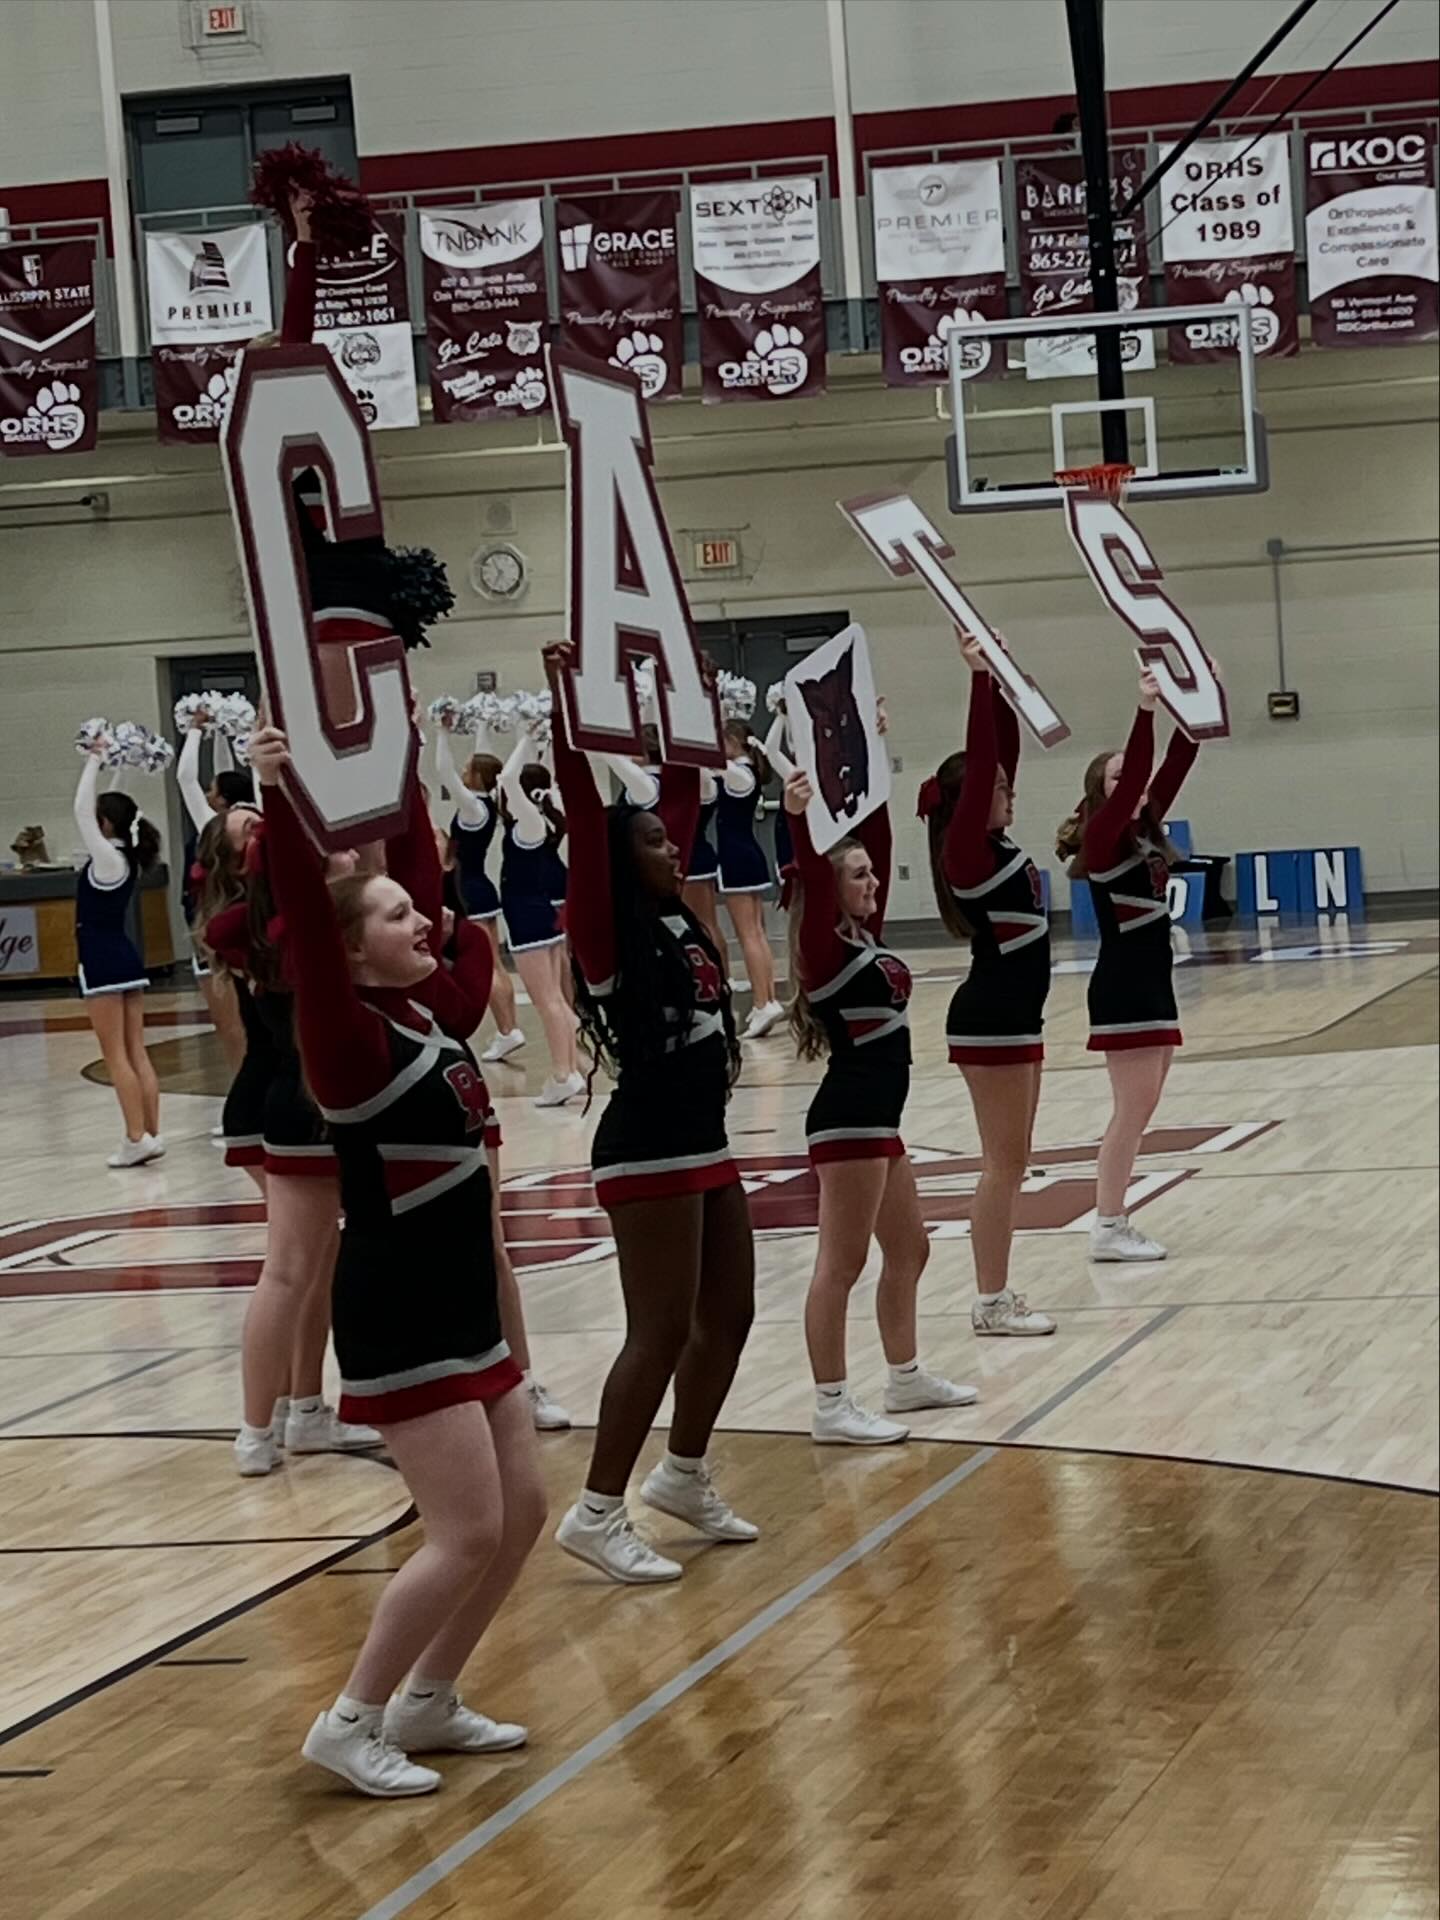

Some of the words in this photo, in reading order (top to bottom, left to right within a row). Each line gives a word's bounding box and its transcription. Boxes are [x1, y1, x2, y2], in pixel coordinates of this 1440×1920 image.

[1339, 134, 1426, 167] KOC
[1185, 157, 1264, 181] ORHS
[1170, 193, 1245, 213] Class
[1257, 184, 1281, 206] of
[877, 209, 999, 231] PREMIER
[1197, 220, 1261, 242] 1989
[594, 228, 675, 253] GRACE
[54, 285, 90, 300] STATE
[168, 301, 253, 320] PREMIER
[718, 357, 800, 379] ORHS
[0, 412, 78, 435] ORHS
[703, 542, 730, 564] EXIT
[220, 344, 418, 856] C
[546, 344, 726, 768] A
[1314, 850, 1348, 910] N
